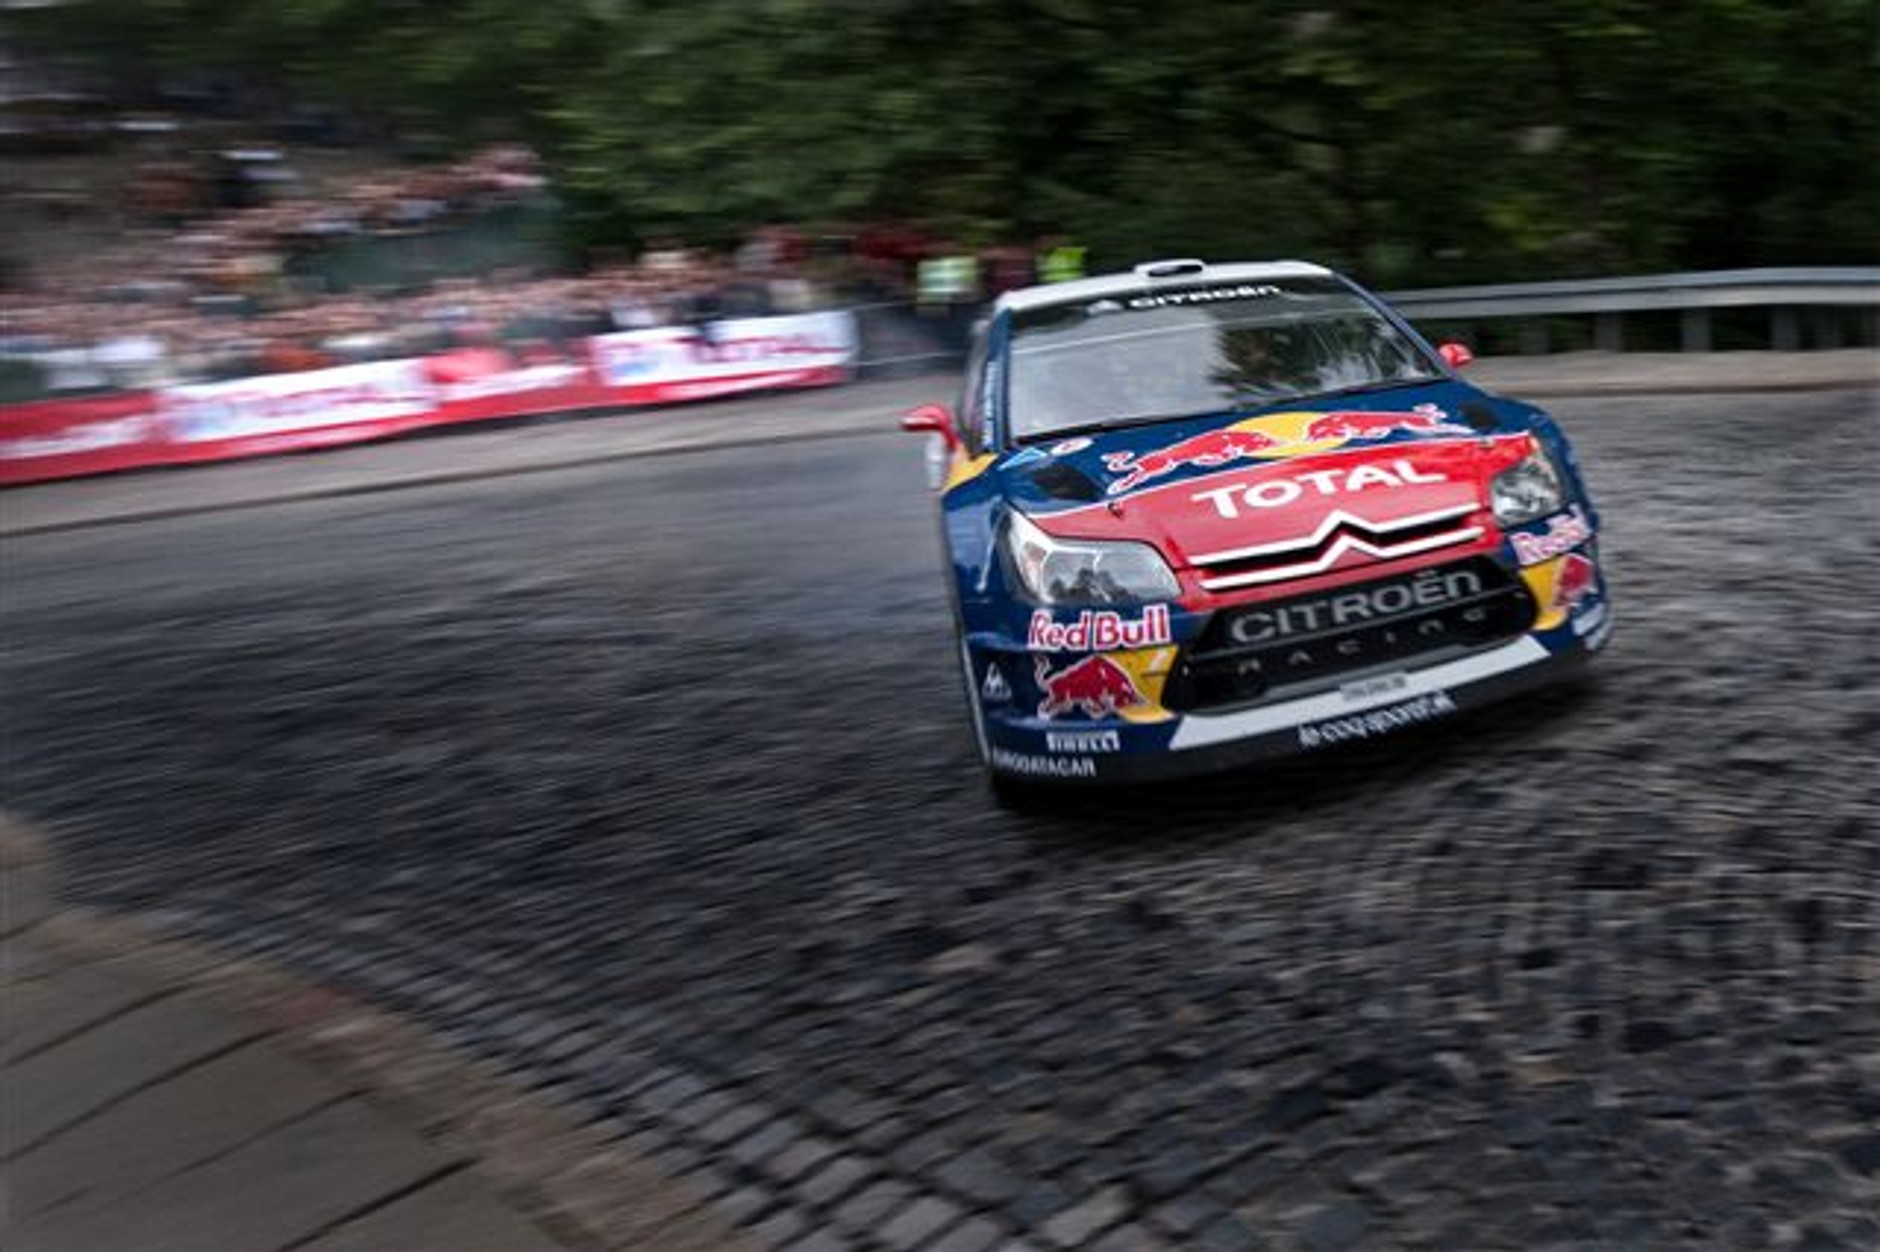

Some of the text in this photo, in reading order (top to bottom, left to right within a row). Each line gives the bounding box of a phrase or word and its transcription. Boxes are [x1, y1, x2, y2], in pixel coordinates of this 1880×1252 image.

[1190, 460, 1447, 519] TOTAL
[1028, 603, 1171, 650] Red Bull
[1230, 569, 1482, 643] CITROËN
